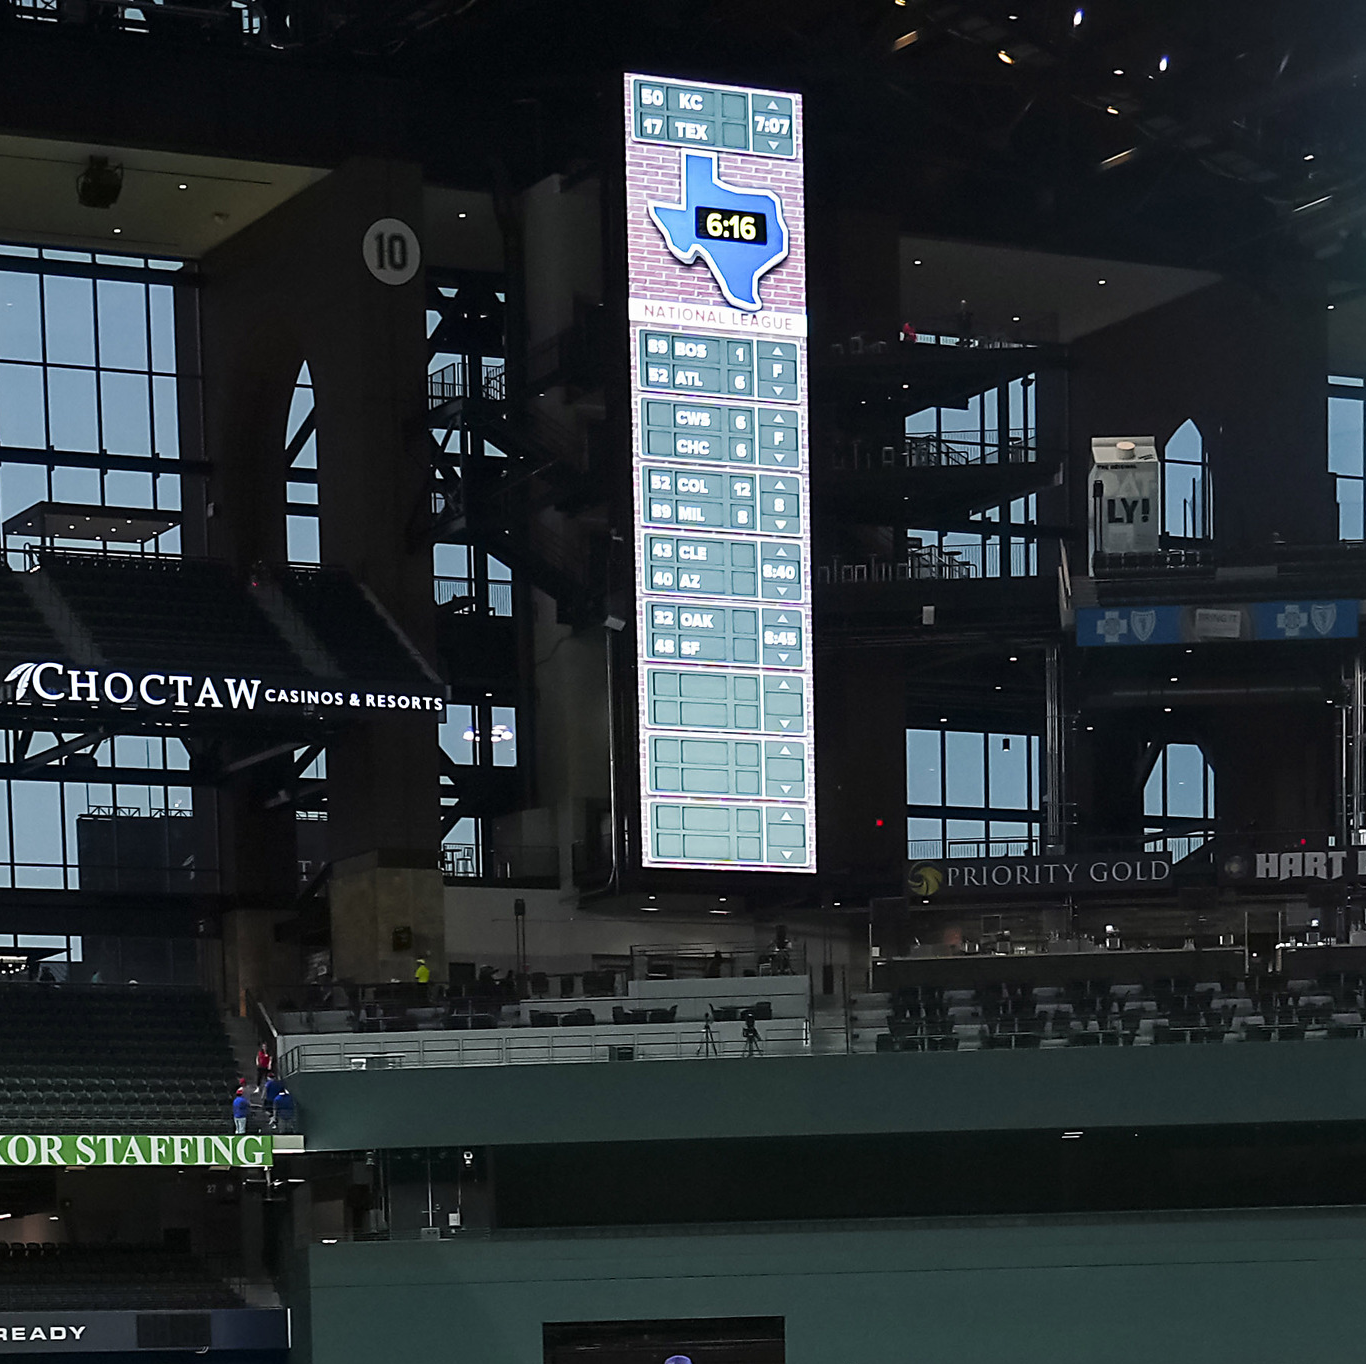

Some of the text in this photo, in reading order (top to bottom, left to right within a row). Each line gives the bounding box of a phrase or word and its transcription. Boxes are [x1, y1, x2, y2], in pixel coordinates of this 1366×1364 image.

[641, 88, 703, 111] 50 KC
[643, 118, 708, 141] 17 TEX
[754, 115, 790, 135] 7:07
[706, 212, 756, 240] 6:16
[376, 234, 408, 271] 10
[644, 304, 793, 331] NATIONAL LEAGUE
[675, 342, 708, 358] BOS
[736, 347, 745, 362] 1
[675, 371, 704, 387] ATL
[735, 375, 746, 390] 6
[772, 363, 783, 378] F
[675, 410, 747, 430] CWS 6
[676, 439, 747, 458] CHC 6
[773, 432, 784, 446] F
[677, 478, 709, 494] COL
[734, 482, 751, 497] 12
[678, 506, 705, 522] MIL
[1107, 498, 1150, 524] LY!
[678, 546, 708, 560] CLE
[653, 572, 701, 589] 40 AZ
[680, 612, 714, 628] OAK
[681, 641, 701, 656] SF
[33, 662, 444, 712] CHOCTAW CASINOS & RESORTS
[947, 860, 1170, 887] PRIORITY GOLD
[1256, 850, 1347, 881] HART
[75, 1135, 265, 1166] STAFFING
